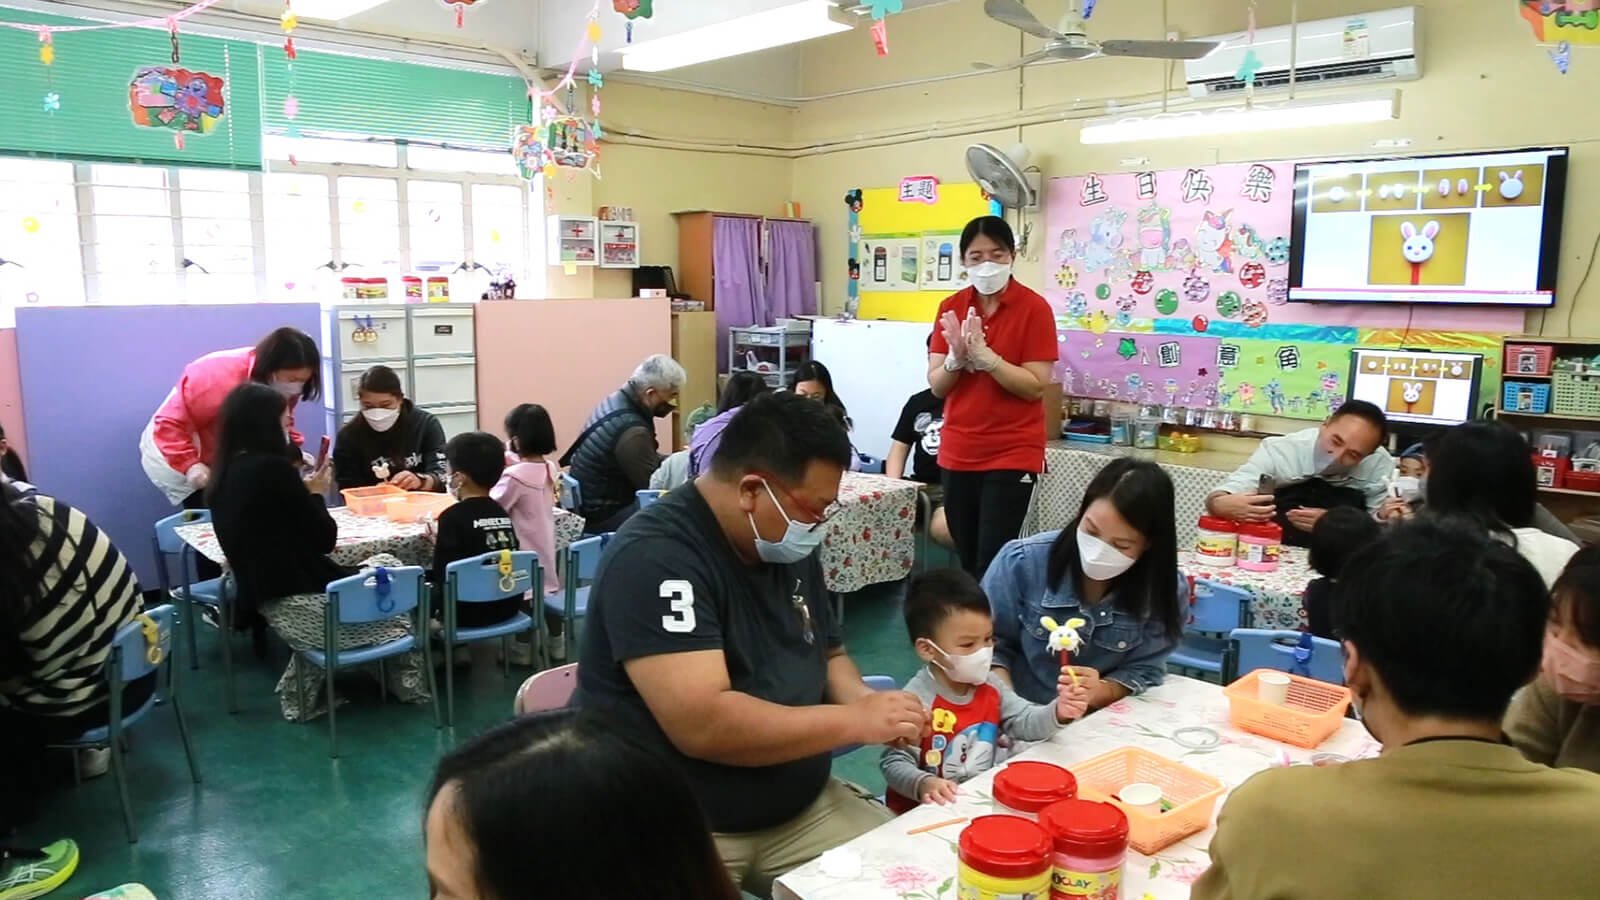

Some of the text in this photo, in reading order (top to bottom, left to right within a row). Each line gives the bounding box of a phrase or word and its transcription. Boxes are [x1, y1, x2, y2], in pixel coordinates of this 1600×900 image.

[901, 180, 934, 200] 主題
[1082, 165, 1274, 205] 生日快樂
[1160, 343, 1299, 370] 創意角
[659, 579, 697, 632] 3
